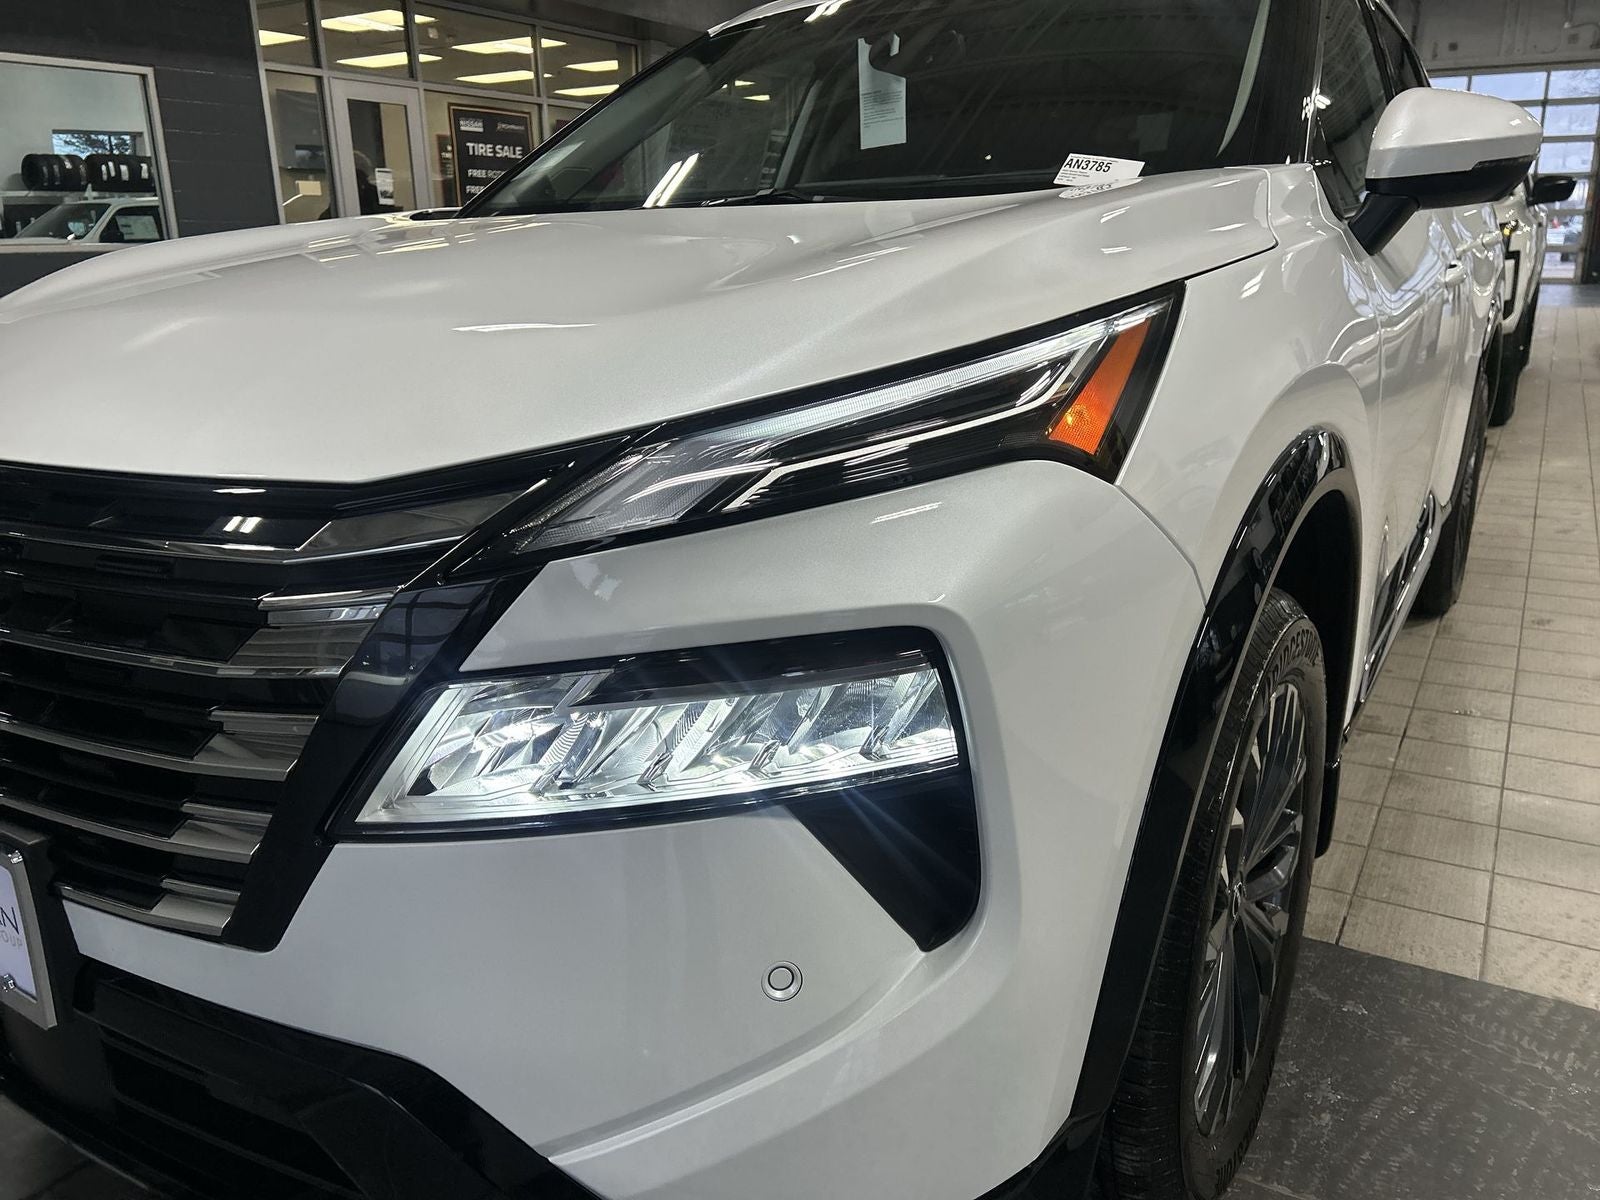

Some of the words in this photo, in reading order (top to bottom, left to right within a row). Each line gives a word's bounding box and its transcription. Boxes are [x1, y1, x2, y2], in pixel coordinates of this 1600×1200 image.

[466, 142, 494, 157] TIRE
[495, 144, 523, 159] SALE
[467, 169, 487, 178] FREE
[1063, 158, 1112, 173] AN3785
[0, 906, 20, 935] N
